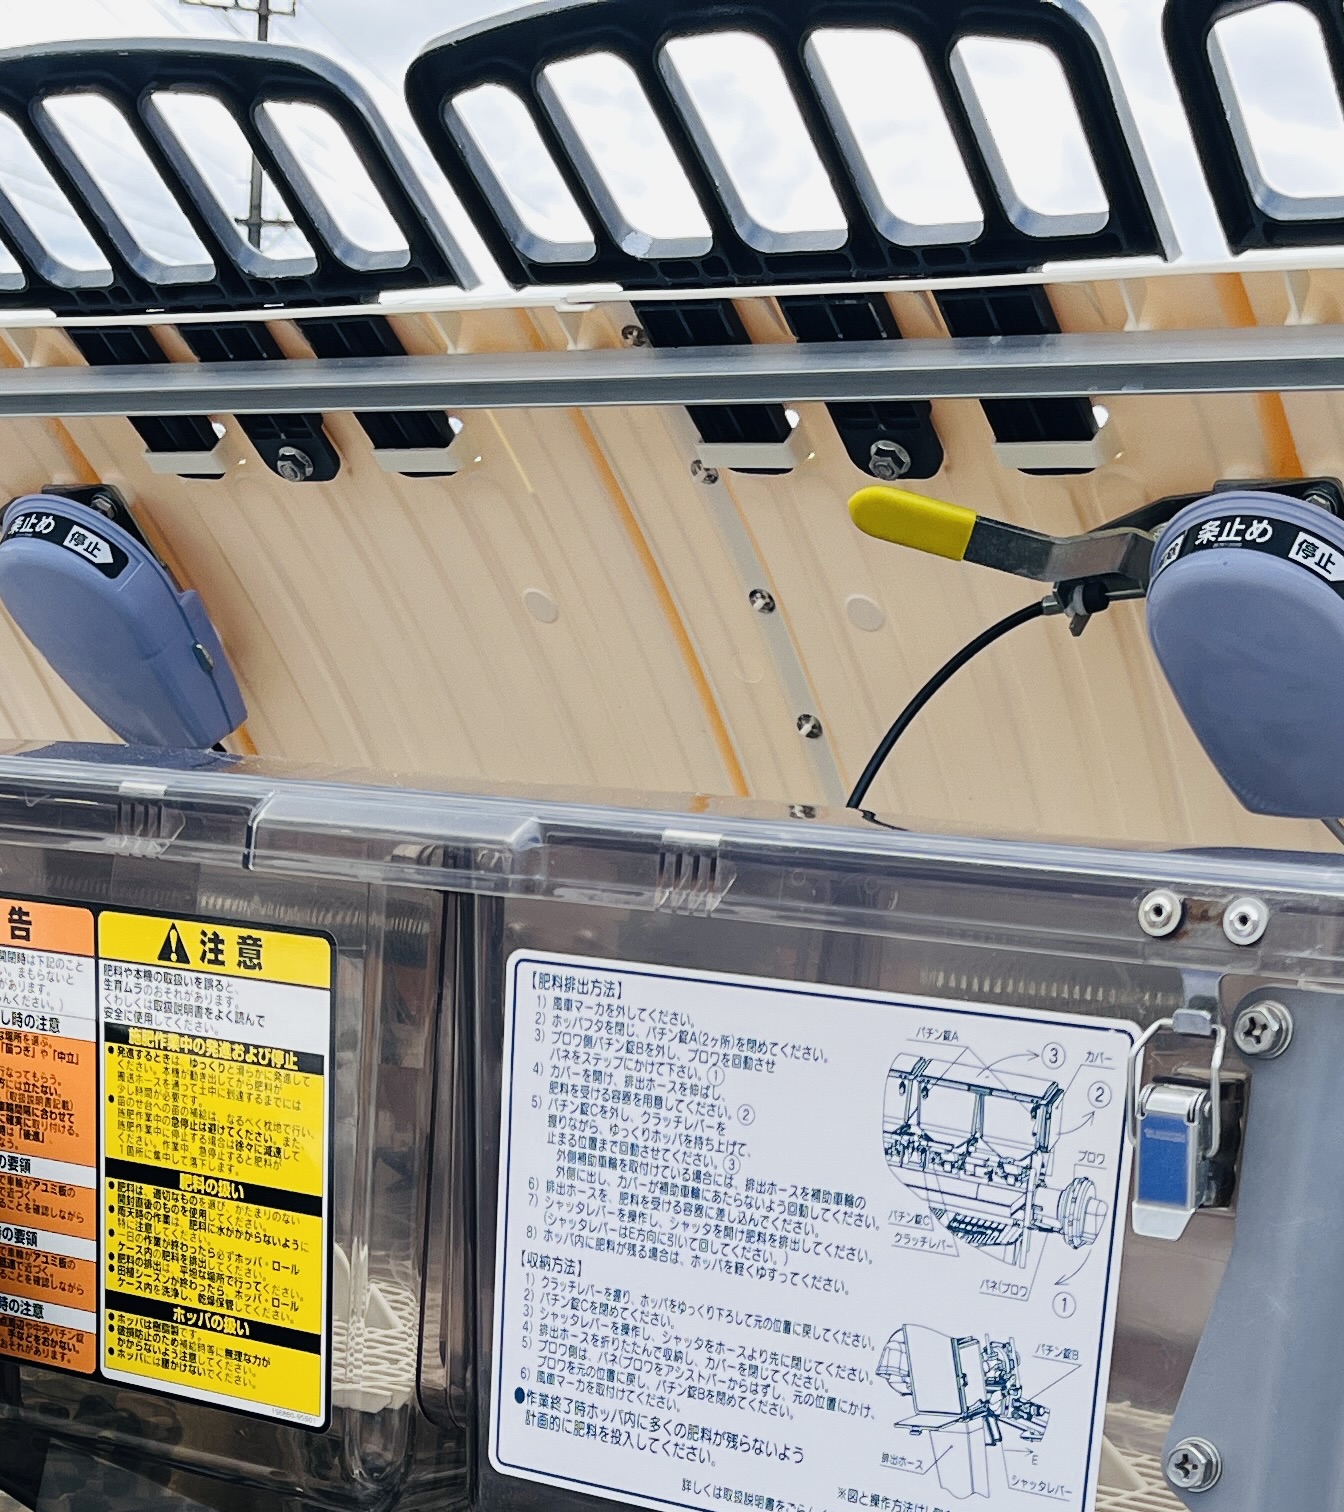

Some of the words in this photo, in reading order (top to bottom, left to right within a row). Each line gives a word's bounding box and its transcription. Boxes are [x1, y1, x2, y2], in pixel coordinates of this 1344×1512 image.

[8, 514, 55, 534] 条止め
[1194, 517, 1273, 545] 条止め
[69, 531, 101, 558] 停止
[1296, 539, 1336, 574] 停止
[199, 930, 263, 971] 注意
[103, 978, 239, 1008] 生育ムラのおそれがあります。
[104, 992, 265, 1028] くわしくは取扱説明書をよく読んで
[104, 1007, 218, 1035] 安全に使用してください。
[128, 1027, 298, 1070] 施肥作業中の発進および停止
[1085, 1051, 1113, 1065] カバー
[179, 1172, 244, 1200] 肥料の扱い
[173, 1305, 249, 1338] ホッパの扱い
